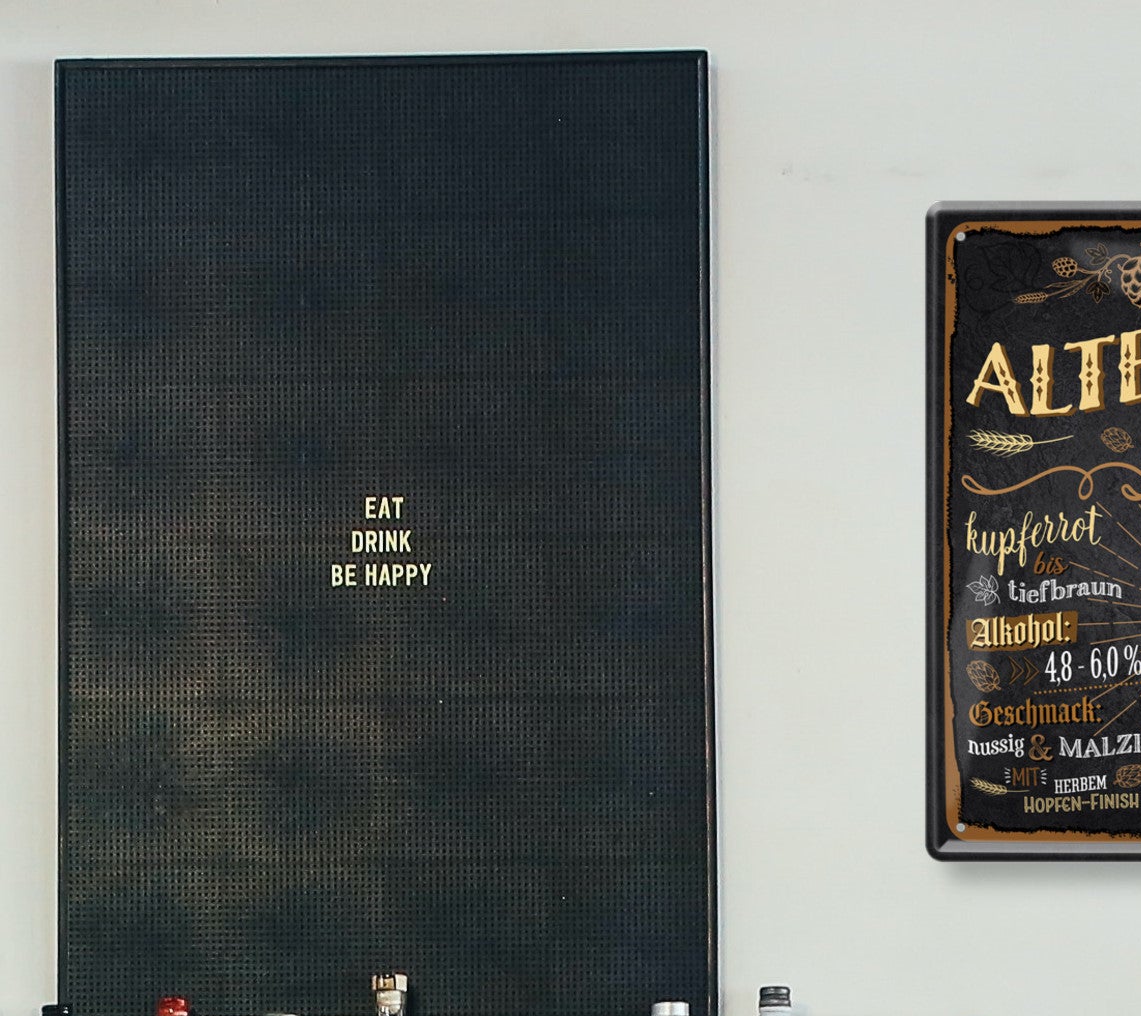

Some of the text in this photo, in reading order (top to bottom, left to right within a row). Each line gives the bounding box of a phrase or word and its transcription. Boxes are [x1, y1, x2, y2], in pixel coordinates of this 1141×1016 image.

[365, 496, 404, 519] EAT
[351, 529, 412, 553] DRINK
[965, 505, 1103, 576] kupferrot
[331, 563, 432, 587] BE HAPPY
[1033, 551, 1070, 575] bis
[1008, 579, 1123, 604] tiefbraun
[971, 611, 1072, 648] Alkohol:
[1044, 651, 1073, 686] 4,8
[1090, 645, 1119, 682] 6,0
[968, 695, 1103, 730] Geschmack:
[967, 733, 1025, 758] nussig
[1028, 733, 1054, 762] &
[1011, 767, 1108, 794] MIT HERBEM
